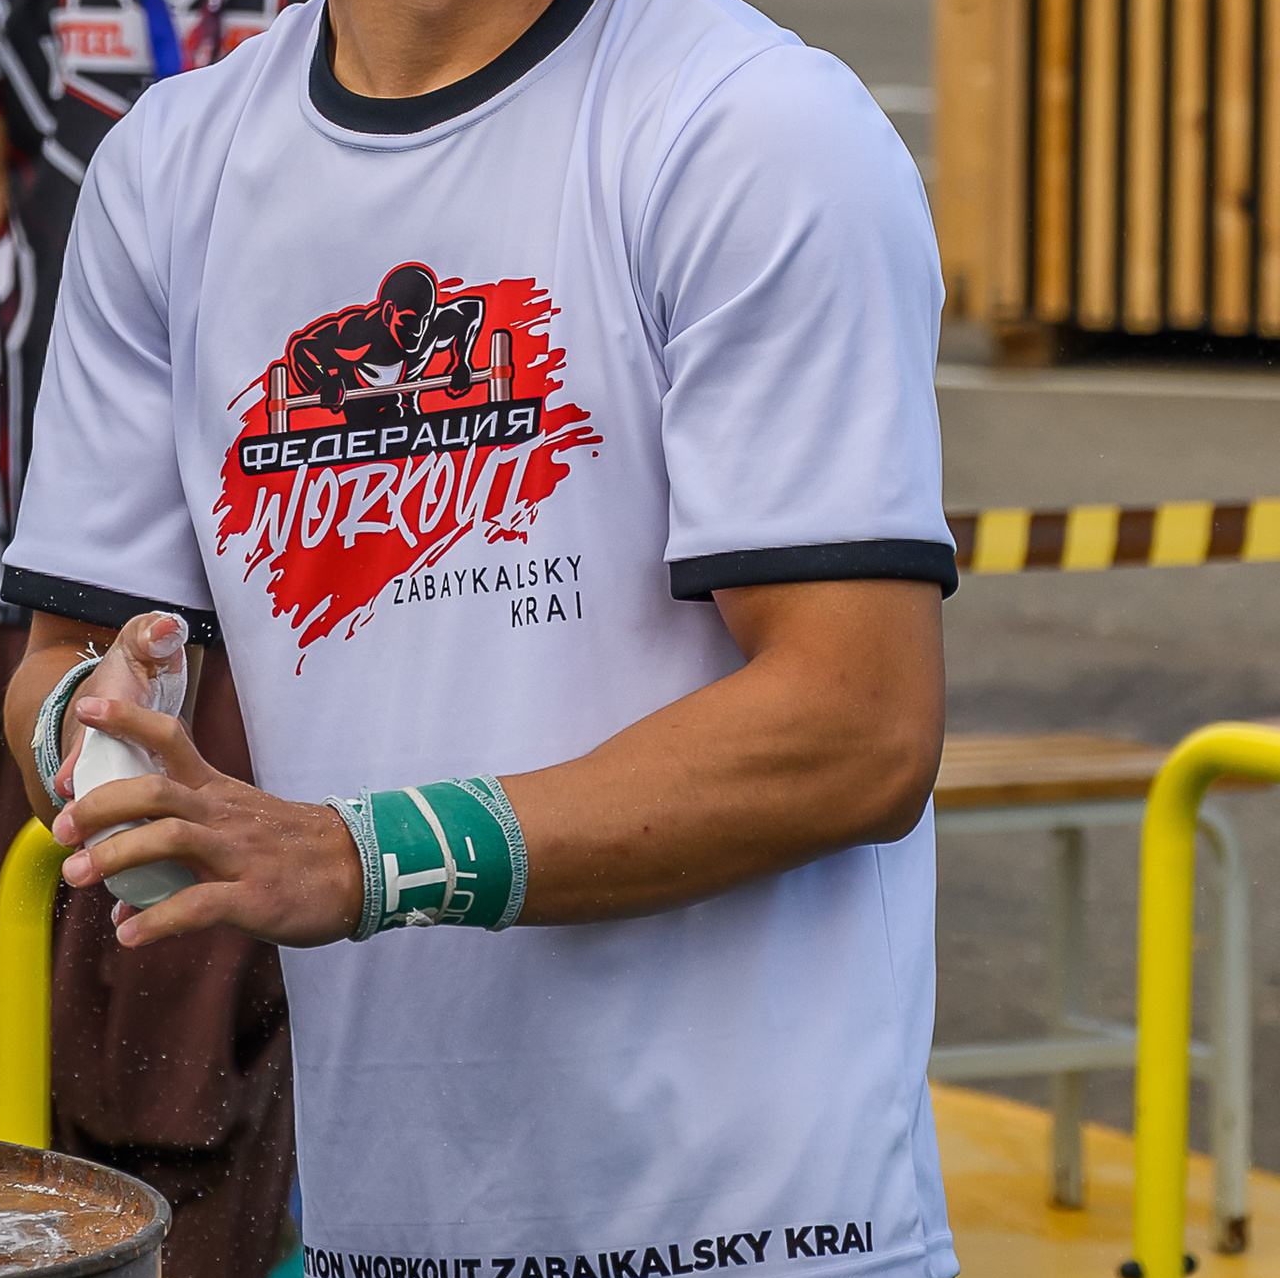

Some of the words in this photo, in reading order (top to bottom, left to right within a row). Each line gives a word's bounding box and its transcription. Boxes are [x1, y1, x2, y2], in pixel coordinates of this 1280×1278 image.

[243, 405, 538, 471] ФЕДЕРАЦИЯ
[247, 430, 547, 556] WORKOUT
[393, 555, 583, 605] ZABAYKALSKY
[511, 591, 583, 628] KRAI
[786, 1221, 873, 1260] KRAI
